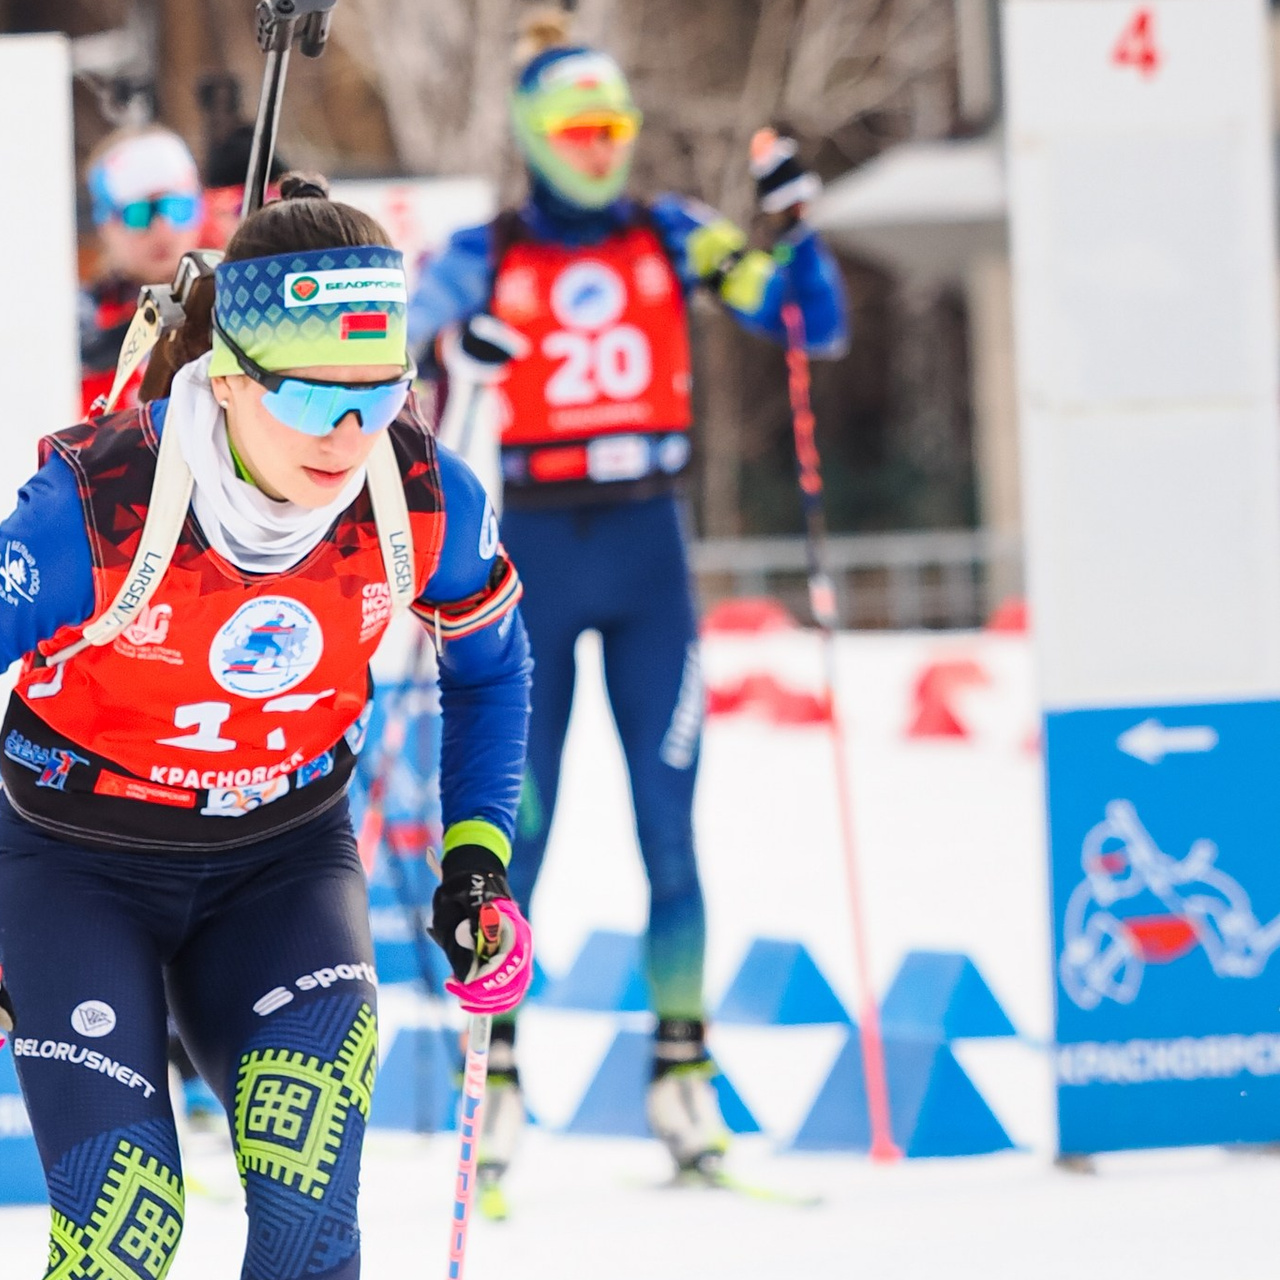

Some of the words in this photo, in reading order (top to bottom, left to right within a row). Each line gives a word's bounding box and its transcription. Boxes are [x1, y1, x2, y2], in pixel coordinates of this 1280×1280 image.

[1109, 7, 1163, 79] 4
[541, 322, 653, 404] 20
[117, 551, 162, 614] LARSEN
[389, 531, 412, 594] LARSEN
[150, 747, 304, 789] КРАСНОЯРСК
[14, 1038, 156, 1099] BELORUSNEFT
